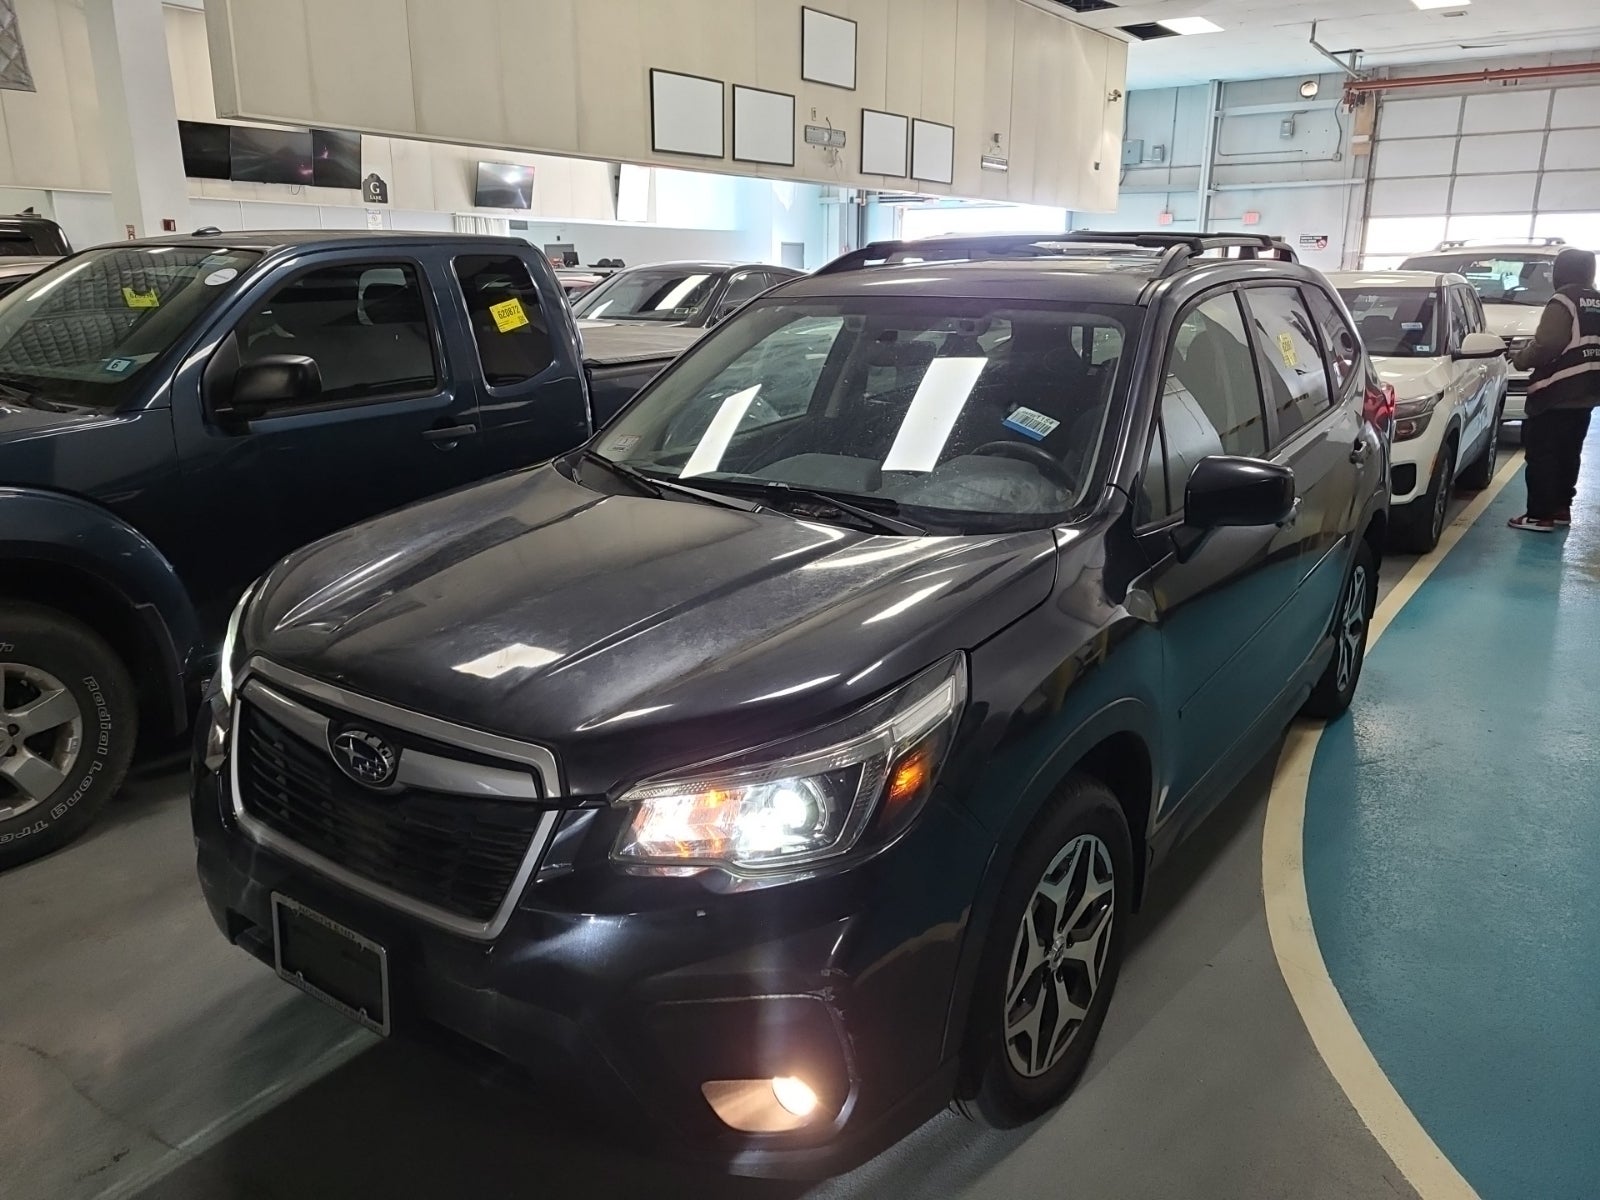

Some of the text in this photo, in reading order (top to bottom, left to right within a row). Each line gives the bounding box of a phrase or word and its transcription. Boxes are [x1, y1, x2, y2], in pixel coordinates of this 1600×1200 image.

[370, 181, 380, 194] G
[83, 676, 112, 756] Radial
[51, 760, 103, 820] Long
